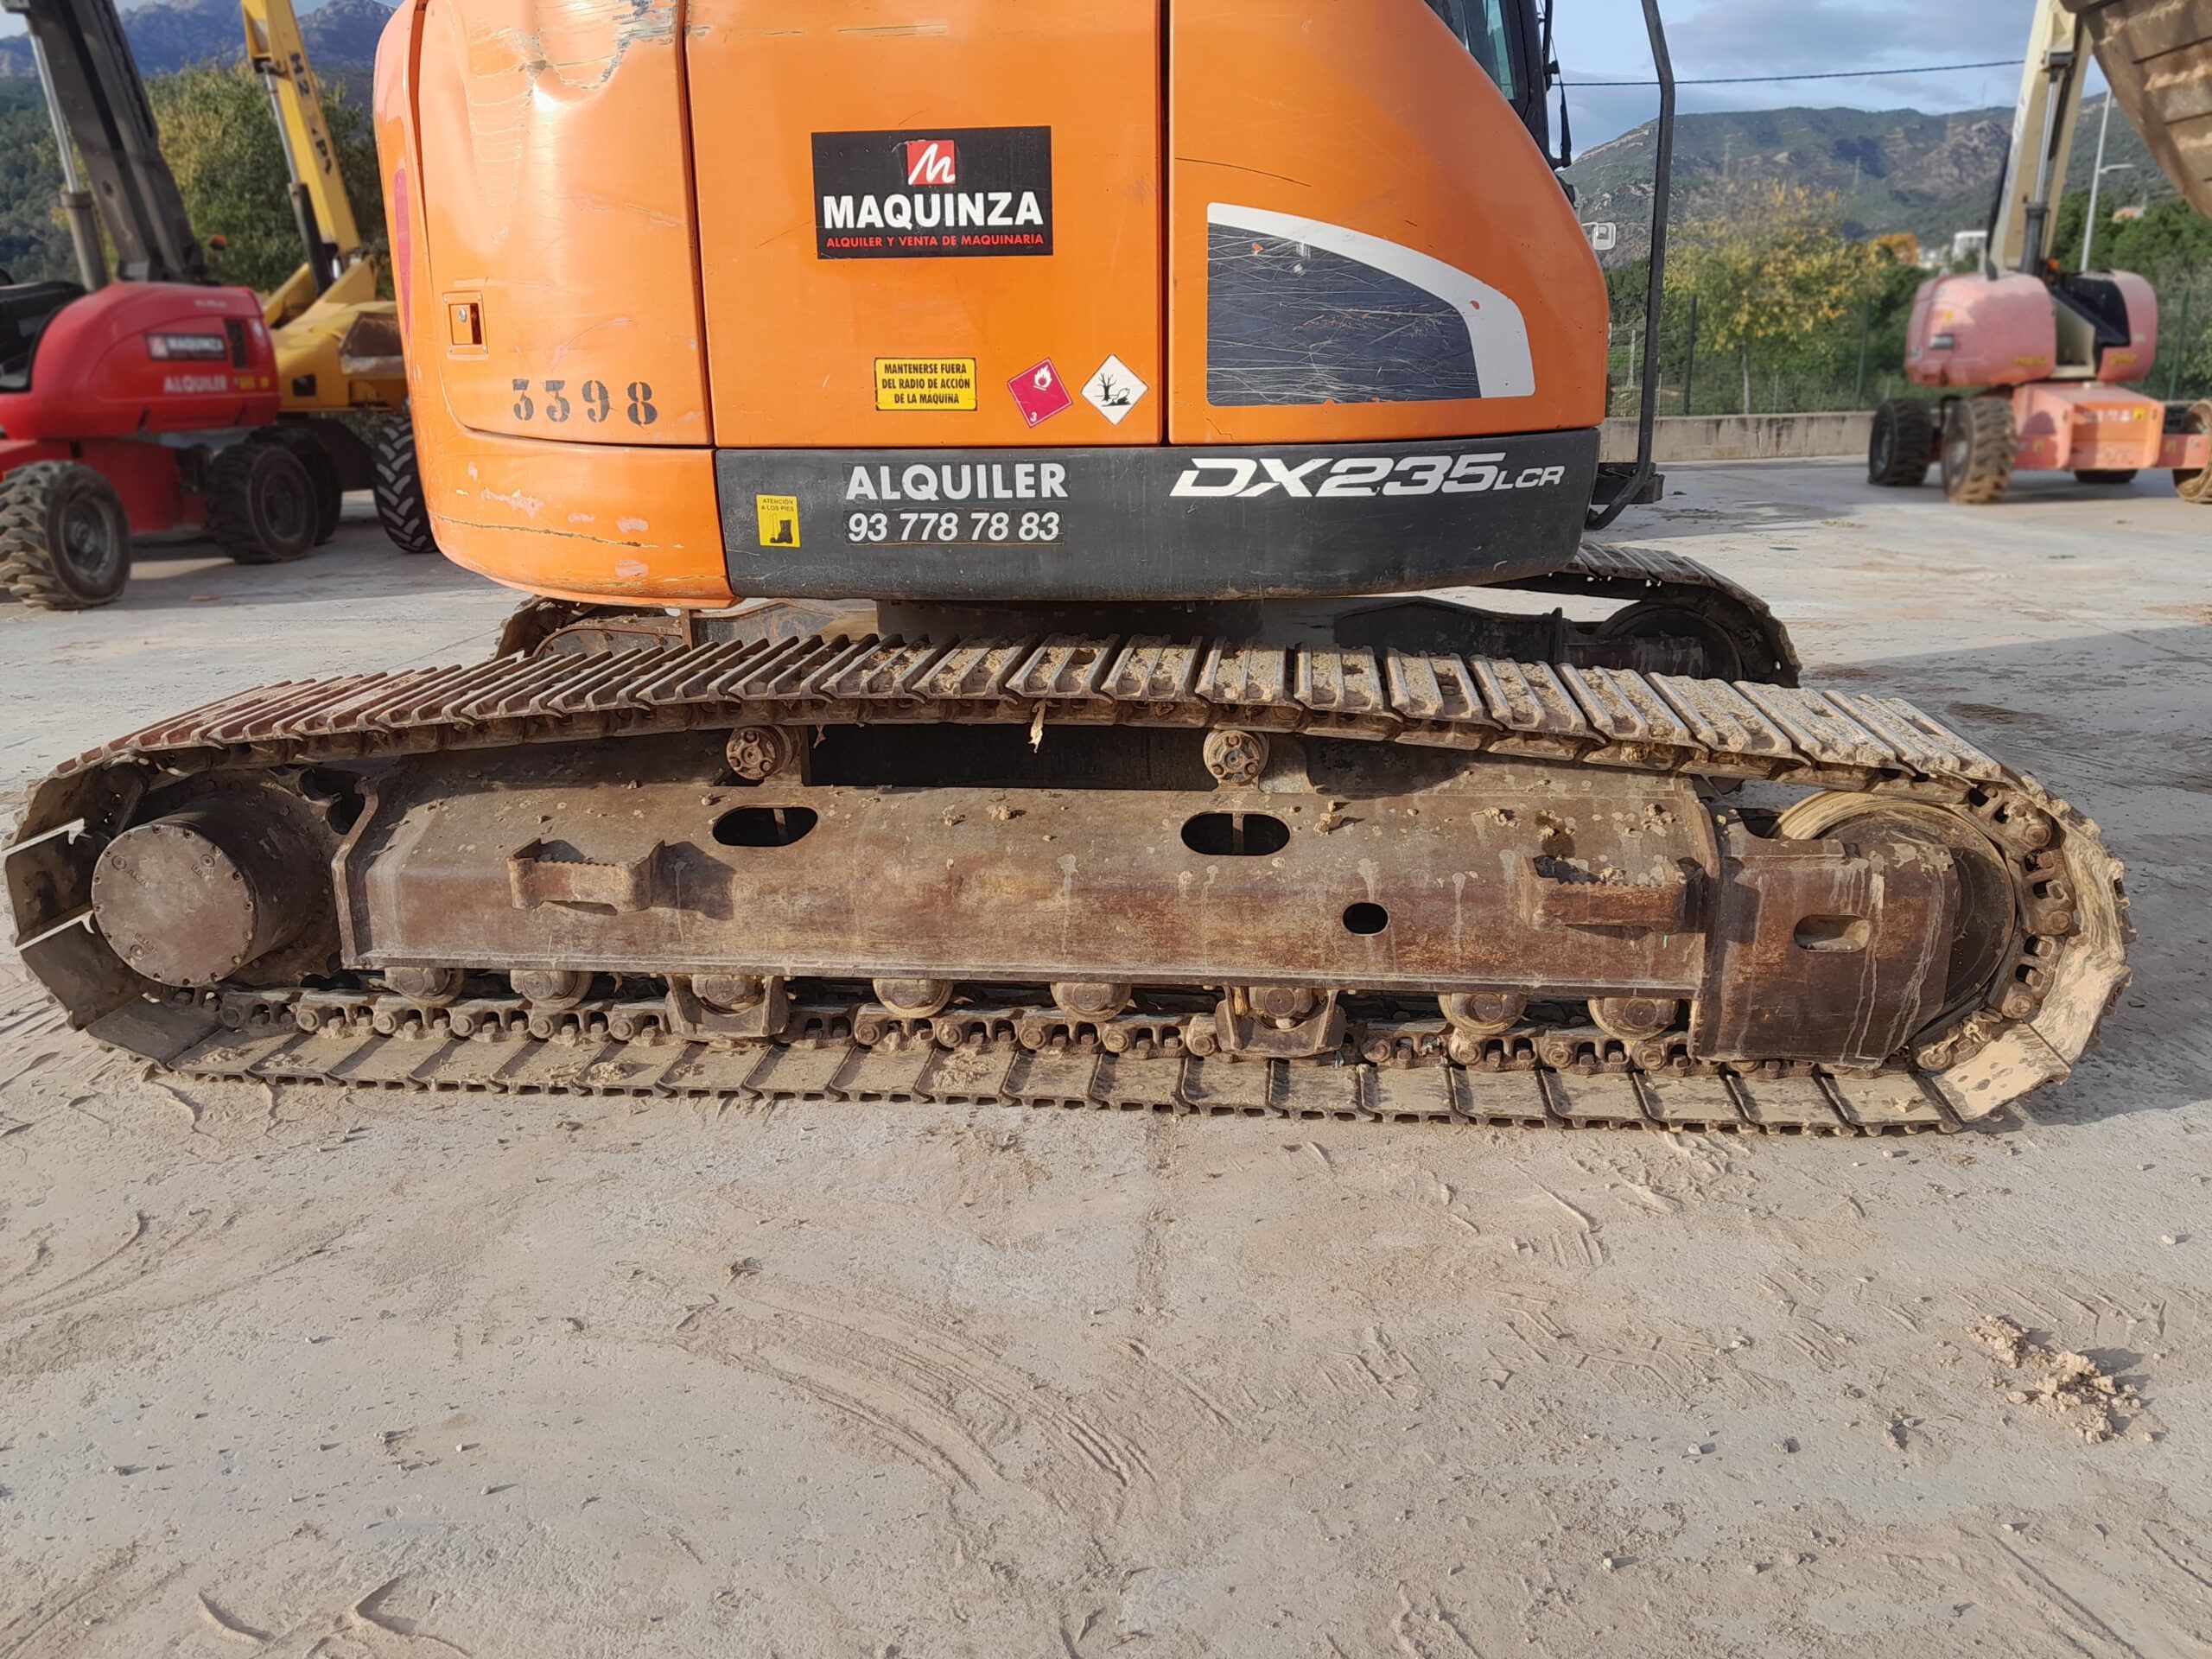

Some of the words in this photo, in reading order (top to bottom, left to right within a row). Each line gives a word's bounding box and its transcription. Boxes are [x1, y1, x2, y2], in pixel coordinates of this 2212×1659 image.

[823, 191, 1044, 230] MAQUINZA
[826, 236, 883, 248] ALQUILER
[887, 236, 895, 247] Y
[899, 236, 938, 247] VENTA
[942, 235, 957, 246] DE
[961, 234, 1044, 245] MAQUINARIA
[884, 363, 938, 374] MANTENERSE
[941, 363, 967, 374] FUERA
[164, 375, 227, 393] ALQUILER
[882, 378, 897, 389] DEL
[899, 378, 925, 389] RADIO
[928, 378, 938, 389] DE
[940, 375, 970, 389] ACCIÓN
[512, 378, 658, 425] 3398
[894, 393, 905, 404] DE
[907, 393, 918, 404] LA
[1030, 411, 1038, 422] 3
[845, 463, 1070, 501] ALQUILER
[848, 512, 888, 542] 93
[899, 512, 959, 542] 778
[970, 512, 1009, 541] 78
[1018, 512, 1060, 541] 83
